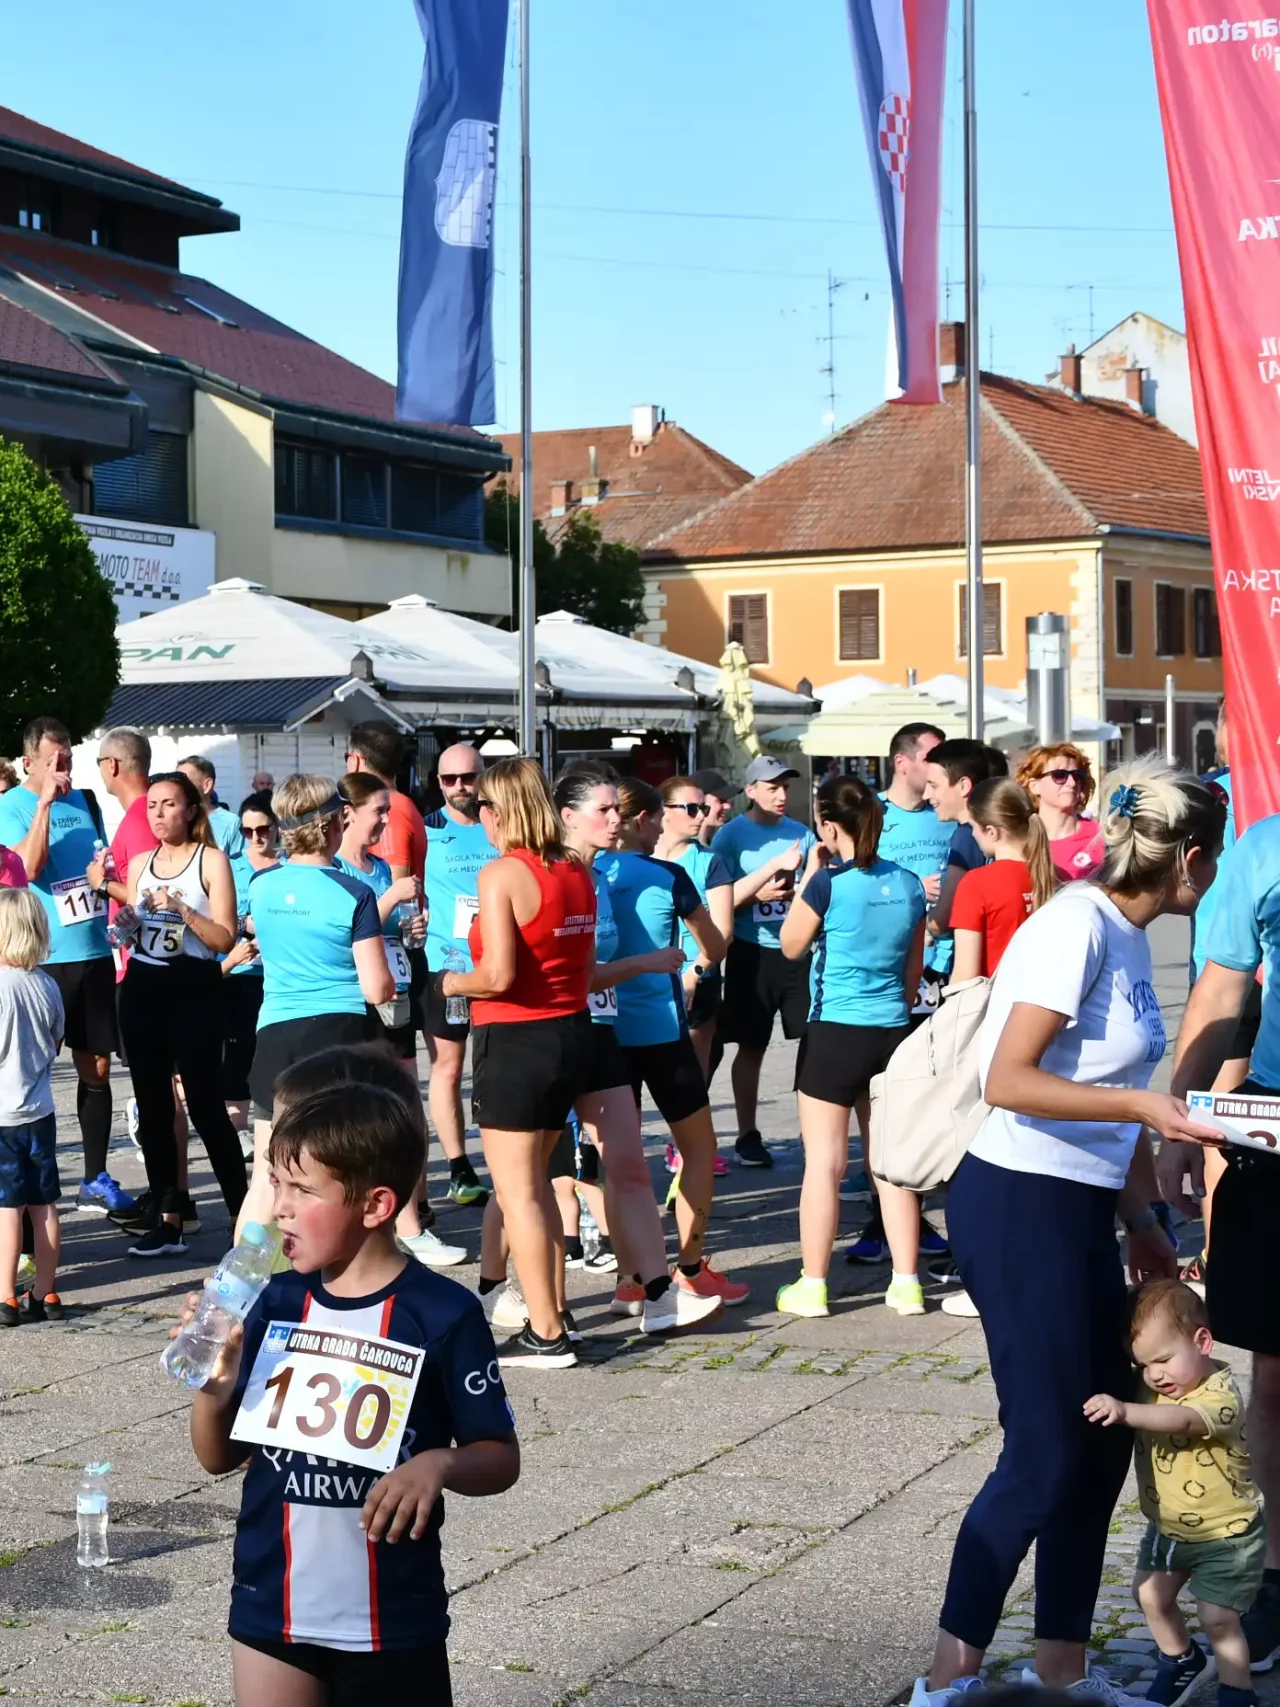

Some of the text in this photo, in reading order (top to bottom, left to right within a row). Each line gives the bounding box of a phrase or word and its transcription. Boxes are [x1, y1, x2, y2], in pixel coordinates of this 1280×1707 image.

[100, 553, 129, 579] MOTO
[133, 557, 160, 580] TEAM
[120, 644, 236, 663] PAN
[64, 891, 103, 917] 112
[1215, 1101, 1248, 1115] UTRKA
[289, 1332, 413, 1374] UTRKA GRADA ČAKOVCA
[264, 1366, 391, 1450] 130
